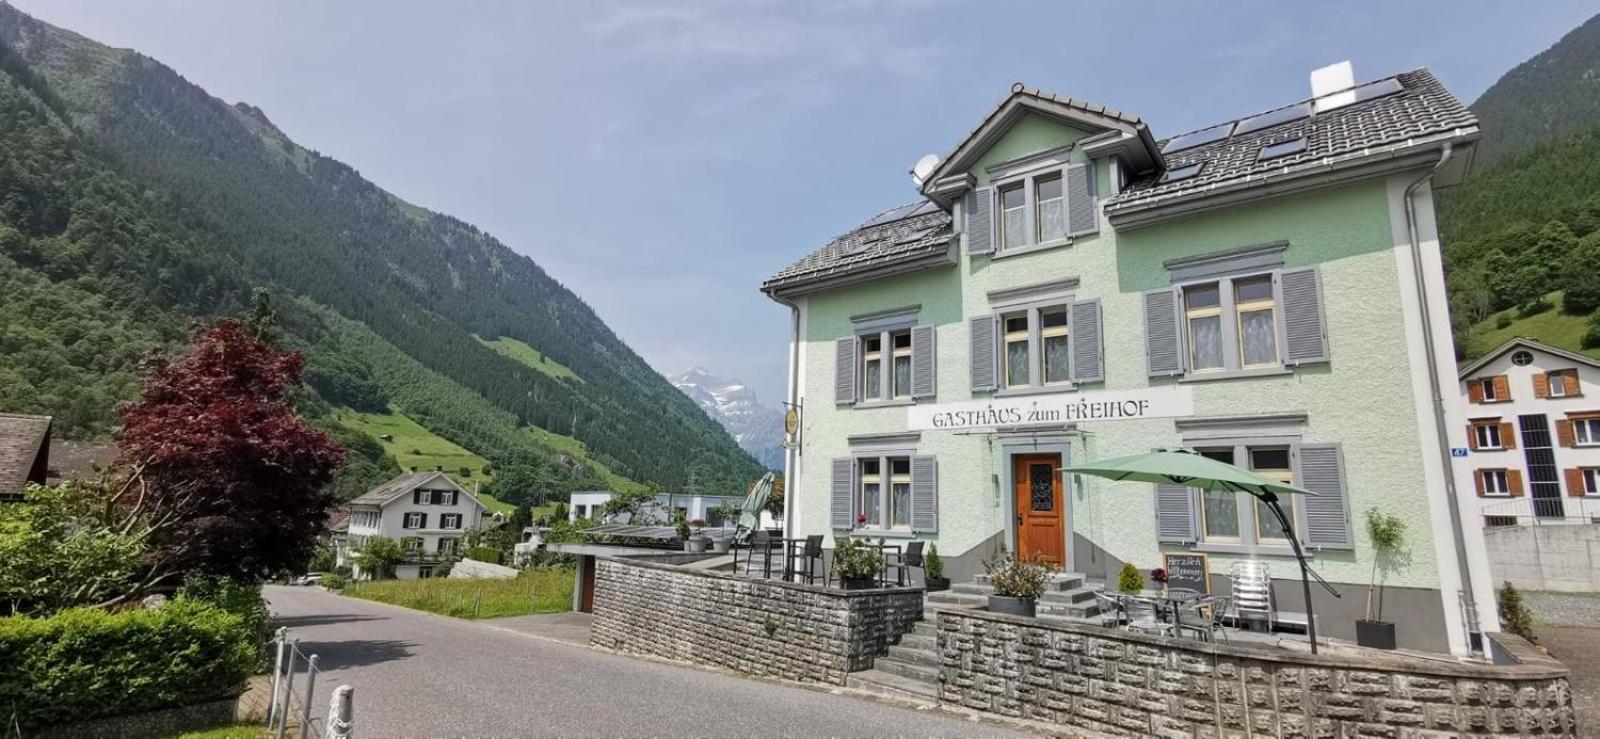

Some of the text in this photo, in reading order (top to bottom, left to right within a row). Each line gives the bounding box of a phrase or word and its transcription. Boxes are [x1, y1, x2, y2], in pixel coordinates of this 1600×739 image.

[932, 399, 1149, 428] GASTHAUS zum FREIHOF
[1168, 556, 1201, 566] Herzlich
